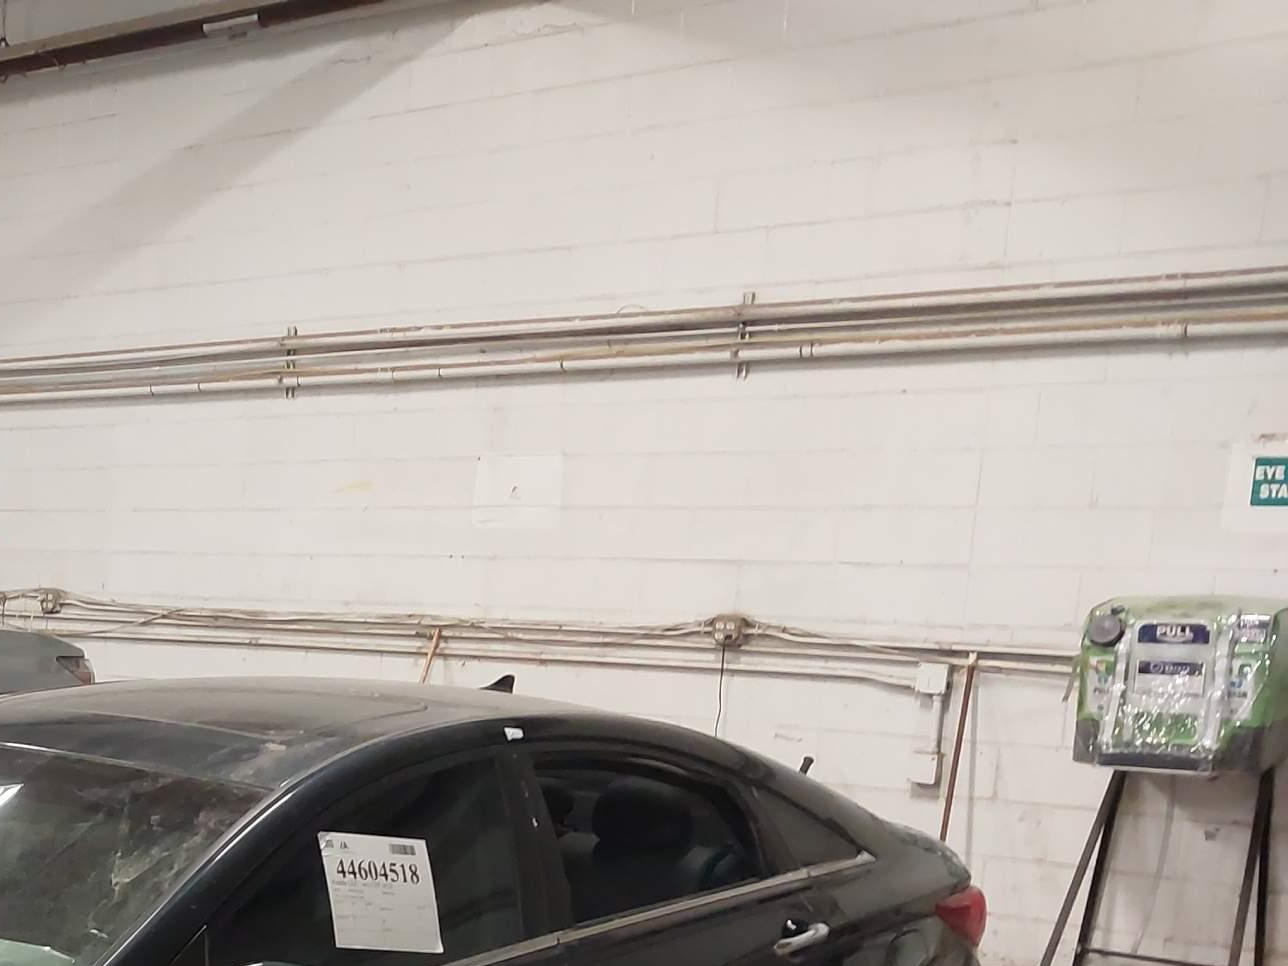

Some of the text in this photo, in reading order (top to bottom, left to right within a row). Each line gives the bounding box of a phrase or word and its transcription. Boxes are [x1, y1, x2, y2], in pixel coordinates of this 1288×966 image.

[1255, 465, 1286, 481] EYE
[1156, 624, 1194, 640] PULL
[336, 859, 420, 885] 44604518
